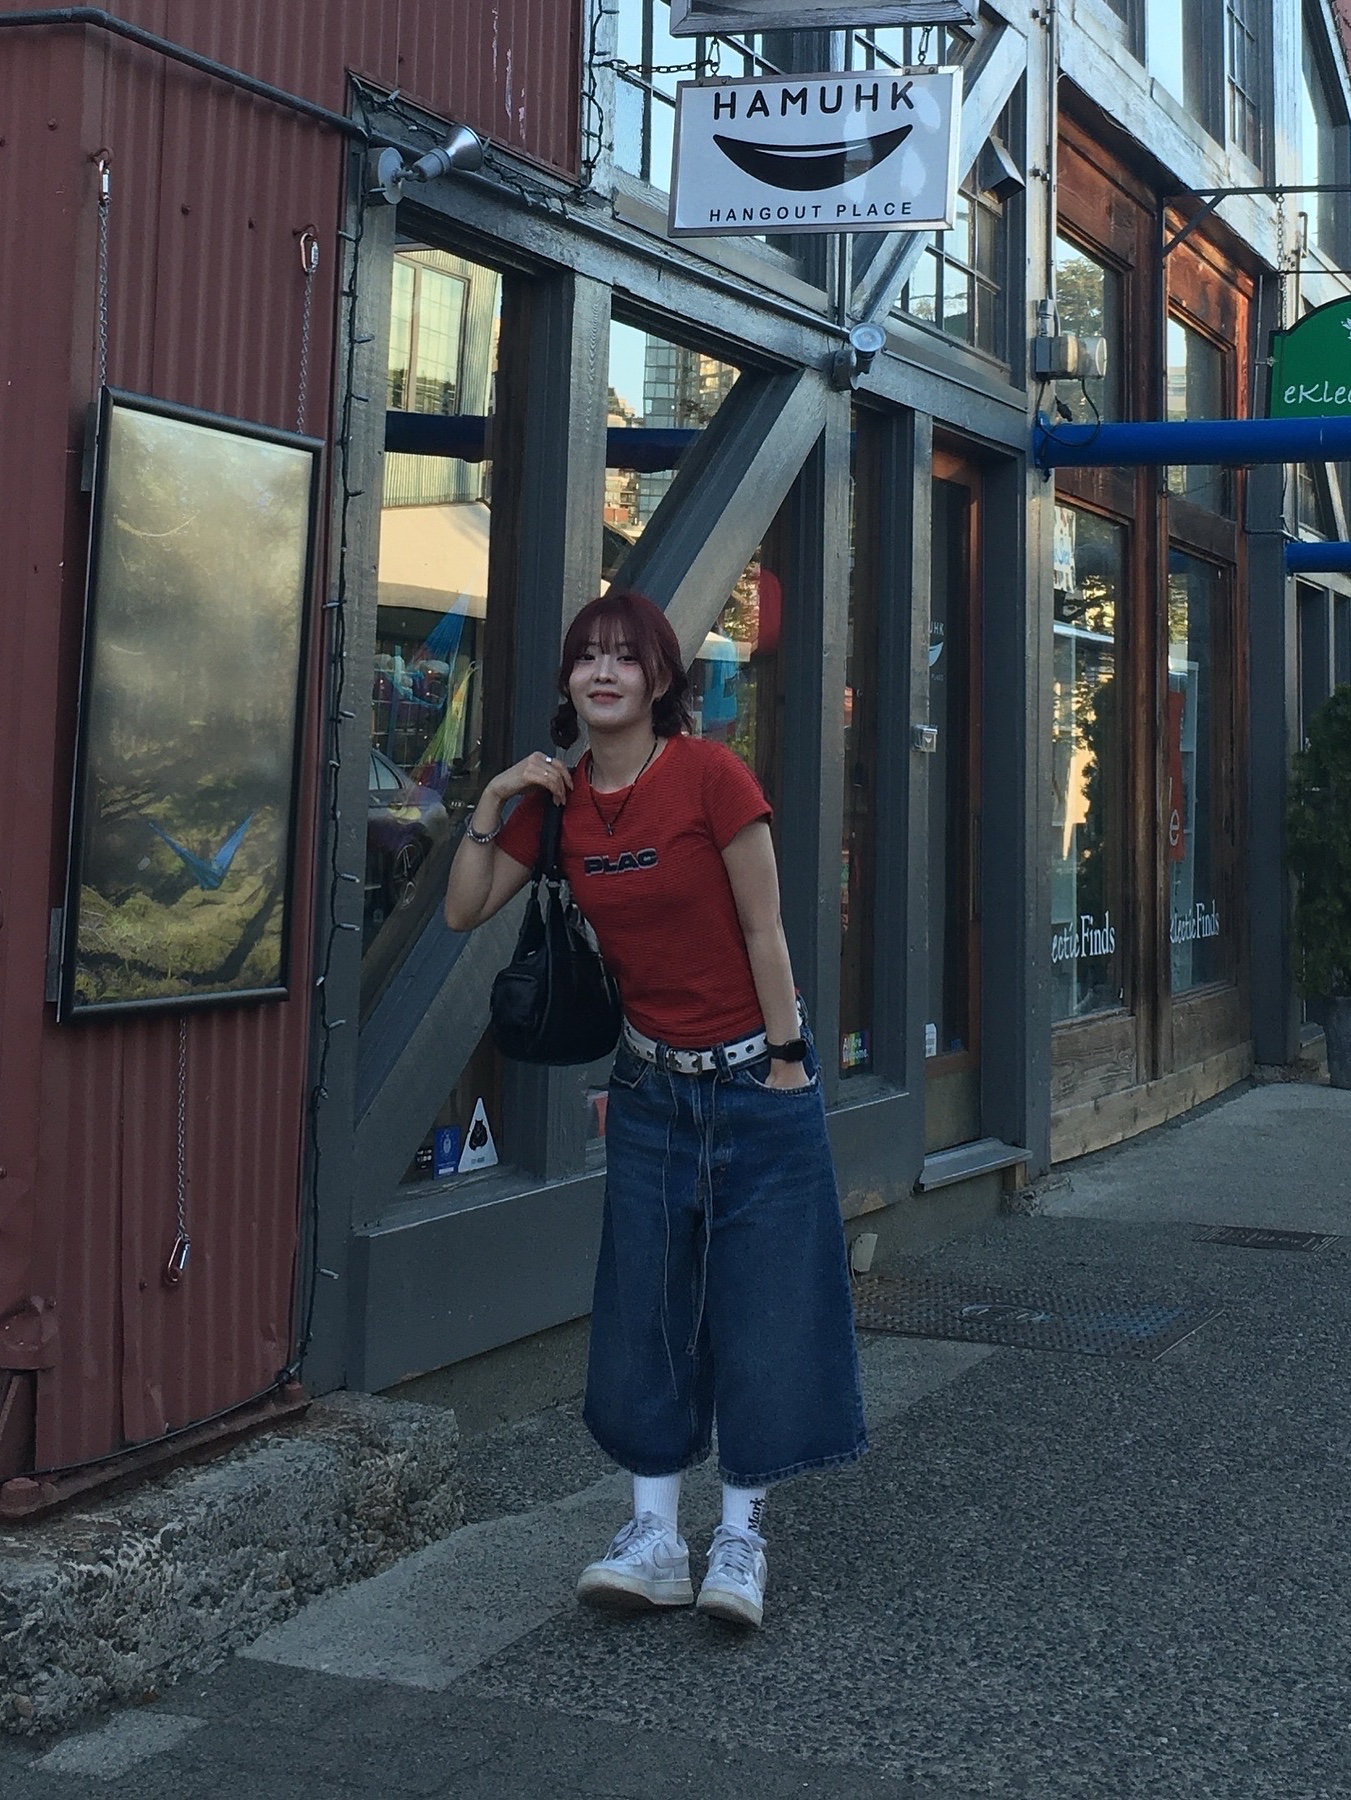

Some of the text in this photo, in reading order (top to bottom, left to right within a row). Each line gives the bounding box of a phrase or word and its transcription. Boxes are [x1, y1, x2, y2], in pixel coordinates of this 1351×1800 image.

[713, 81, 914, 120] HAMUHK
[709, 202, 912, 222] HANGOUT PLACE
[1080, 910, 1115, 957] Finds
[1196, 899, 1219, 939] Finds
[747, 1497, 765, 1533] Mark
